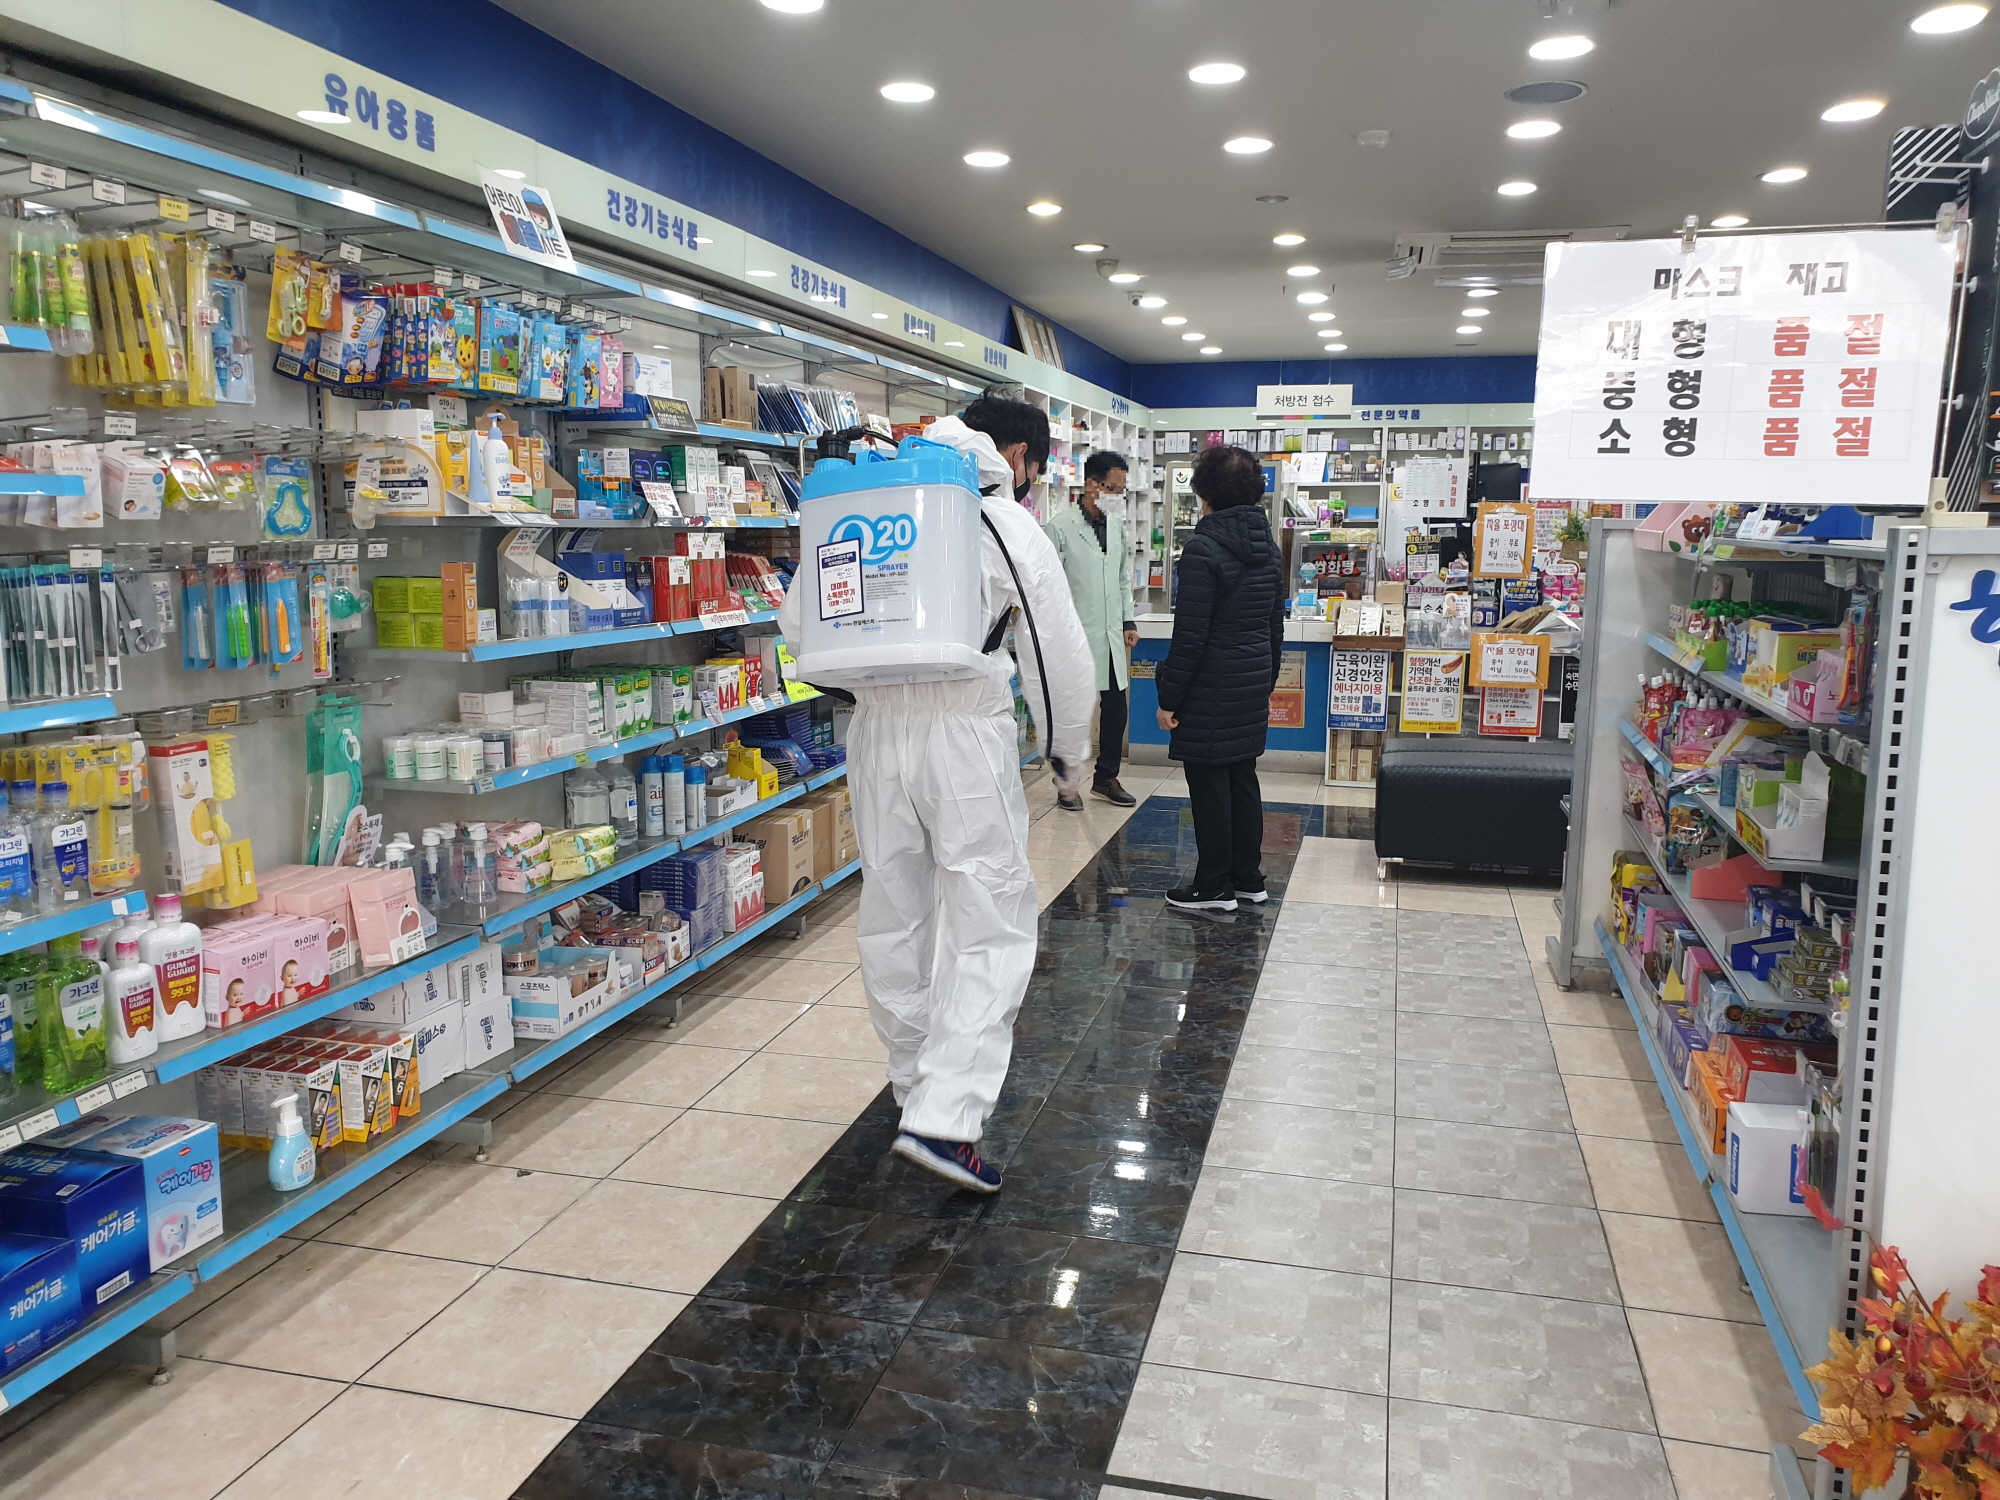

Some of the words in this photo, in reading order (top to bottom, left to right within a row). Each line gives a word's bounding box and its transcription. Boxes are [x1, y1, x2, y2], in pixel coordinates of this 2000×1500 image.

[324, 73, 436, 152] 유아용품
[484, 183, 526, 216] 어린이
[607, 188, 698, 251] 건강기능식품
[790, 264, 847, 309] 건강기능식품
[1654, 266, 1743, 300] 마스크
[1786, 261, 1849, 296] 재고
[1606, 319, 1642, 361] 대
[1672, 318, 1707, 360] 형
[1773, 316, 1811, 357] 품
[1844, 313, 1885, 355] 절
[1602, 369, 1636, 411] 중
[1667, 368, 1702, 411] 형
[1768, 368, 1805, 409] 품
[1837, 366, 1878, 408] 절
[1273, 394, 1308, 407] 처방전
[1312, 394, 1335, 407] 접수
[1360, 409, 1421, 421] 전문의약품
[1597, 418, 1631, 455] 소
[1662, 416, 1697, 457] 형
[1763, 416, 1800, 457] 품
[1832, 415, 1872, 457] 절
[1503, 519, 1524, 532] 포장대
[877, 562, 909, 572] SPRAYER
[1314, 560, 1355, 575] 쌍화탕
[826, 588, 856, 600] 소독분무기
[1508, 647, 1535, 656] 포장대
[1335, 654, 1385, 668] 근육이완
[1409, 656, 1441, 667] 혈행개선
[1334, 668, 1384, 683] 신경안정
[1408, 667, 1432, 676] 기억력
[1408, 676, 1432, 686] 건조한
[1433, 677, 1442, 686] 눈
[1443, 677, 1460, 687] 개선
[1334, 682, 1383, 695] 에너지이용
[1407, 685, 1424, 693] 울트라
[1438, 686, 1459, 694] 오메가3
[1332, 703, 1360, 712] 마그네슘
[60, 825, 83, 838] 가그린
[294, 932, 320, 947] 하이비
[241, 949, 267, 965] 하이비
[167, 961, 187, 971] GUM
[167, 965, 196, 978] GUARD
[69, 979, 99, 998] 가그린
[520, 981, 551, 990] 스포츠텍스
[128, 993, 144, 1003] GUM
[129, 997, 151, 1009] GUARD
[397, 1081, 404, 1093] 6
[367, 1101, 375, 1113] 5
[315, 1114, 323, 1127] 5
[159, 1159, 213, 1194] 케어가글
[80, 1209, 137, 1254] 케어가글
[9, 1277, 62, 1321] 케어가글
